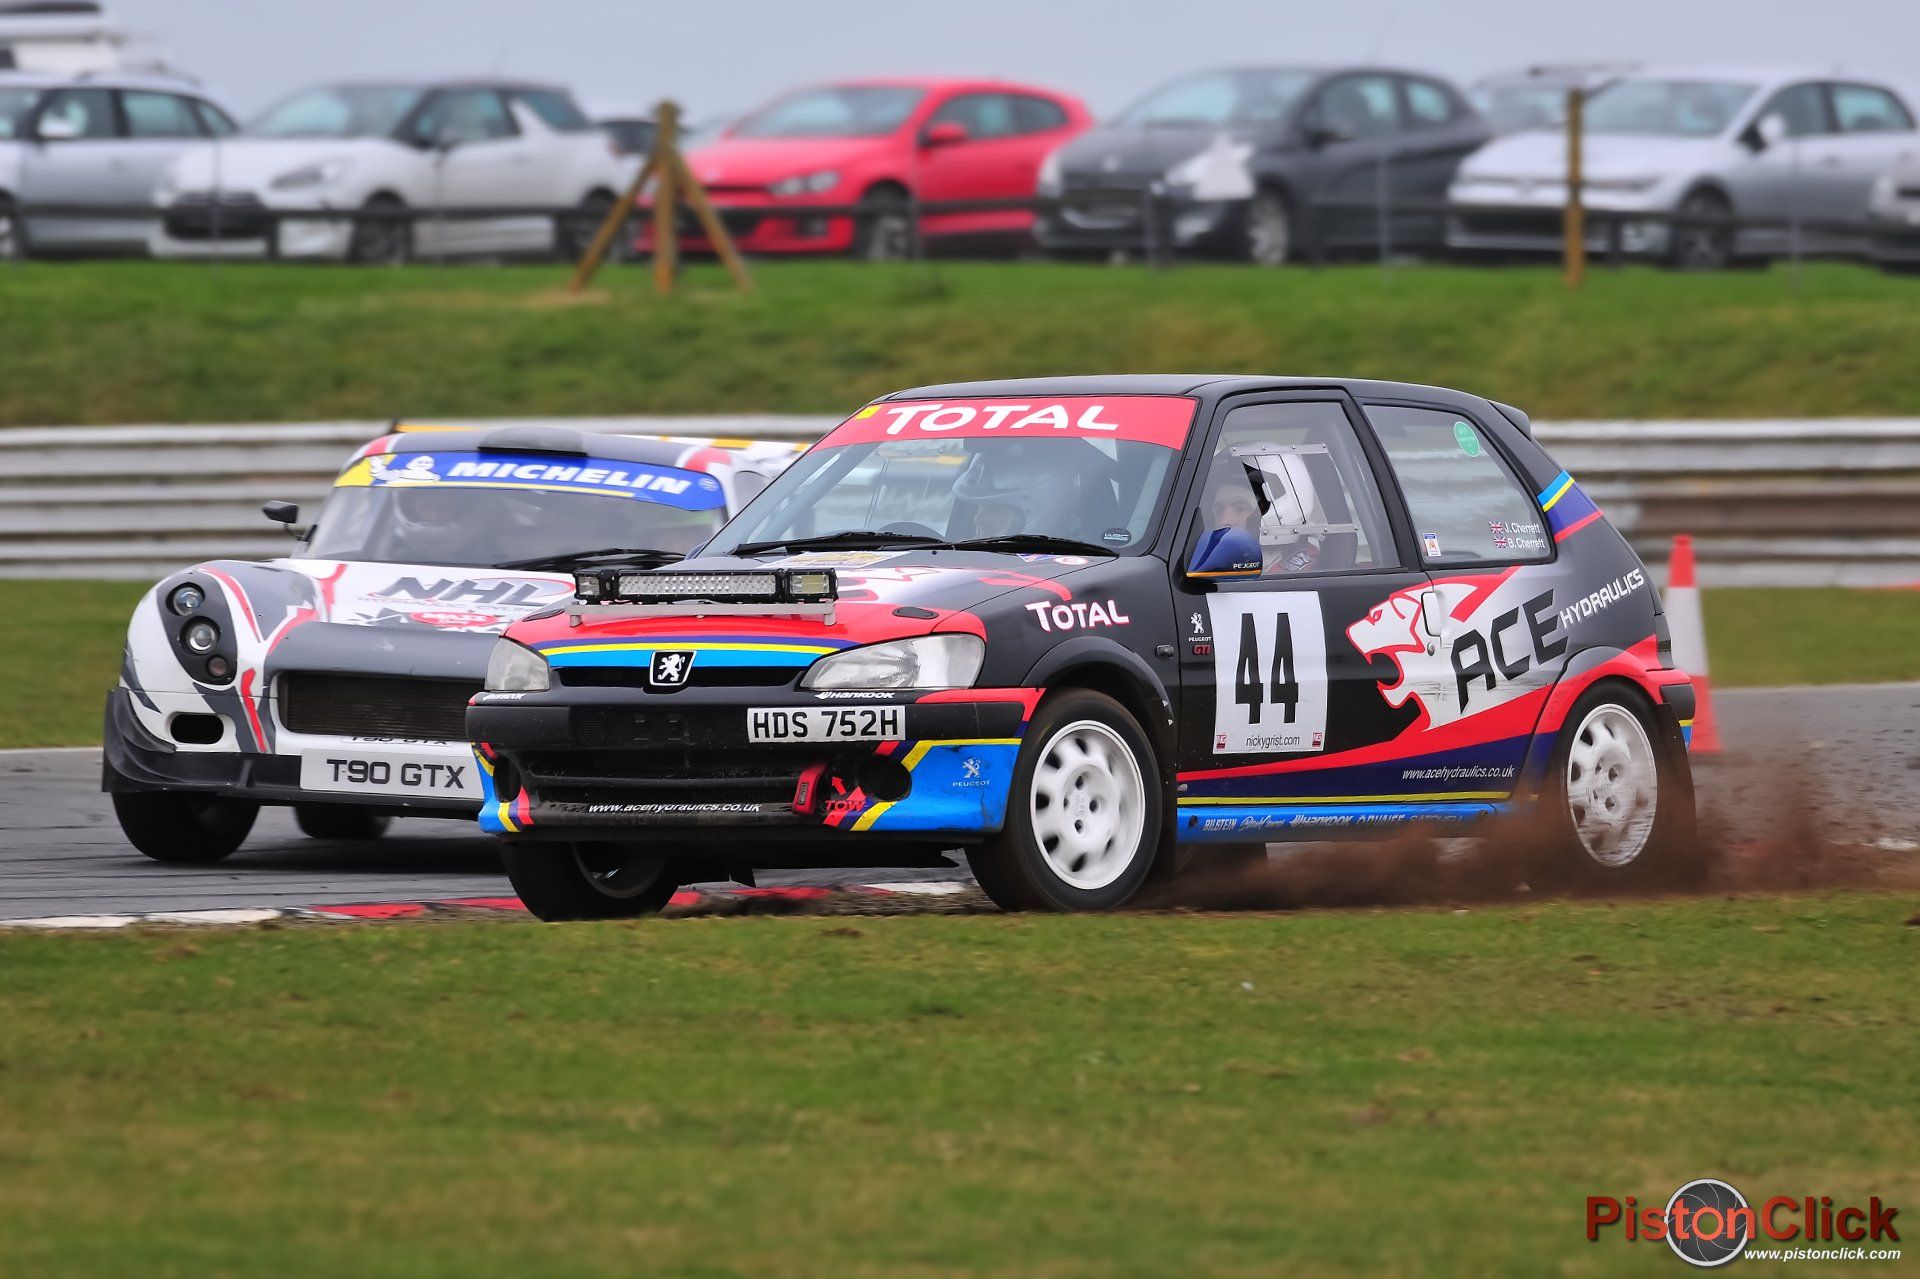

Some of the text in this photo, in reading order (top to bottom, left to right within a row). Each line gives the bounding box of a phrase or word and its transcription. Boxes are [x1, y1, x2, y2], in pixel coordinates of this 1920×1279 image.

[886, 404, 1119, 435] TOTAL
[446, 461, 693, 495] MICHELIN
[376, 576, 547, 607] NHL
[1025, 600, 1129, 632] TOTAL
[1451, 567, 1645, 715] ACE HYDRAULICS
[1235, 613, 1299, 724] 44
[754, 710, 897, 739] HDS 752H
[1246, 735, 1301, 749] nickygrist.com
[326, 758, 465, 789] T90 GTX
[1402, 765, 1515, 781] www.acehydraulics.co.uk
[825, 800, 867, 812] TOW
